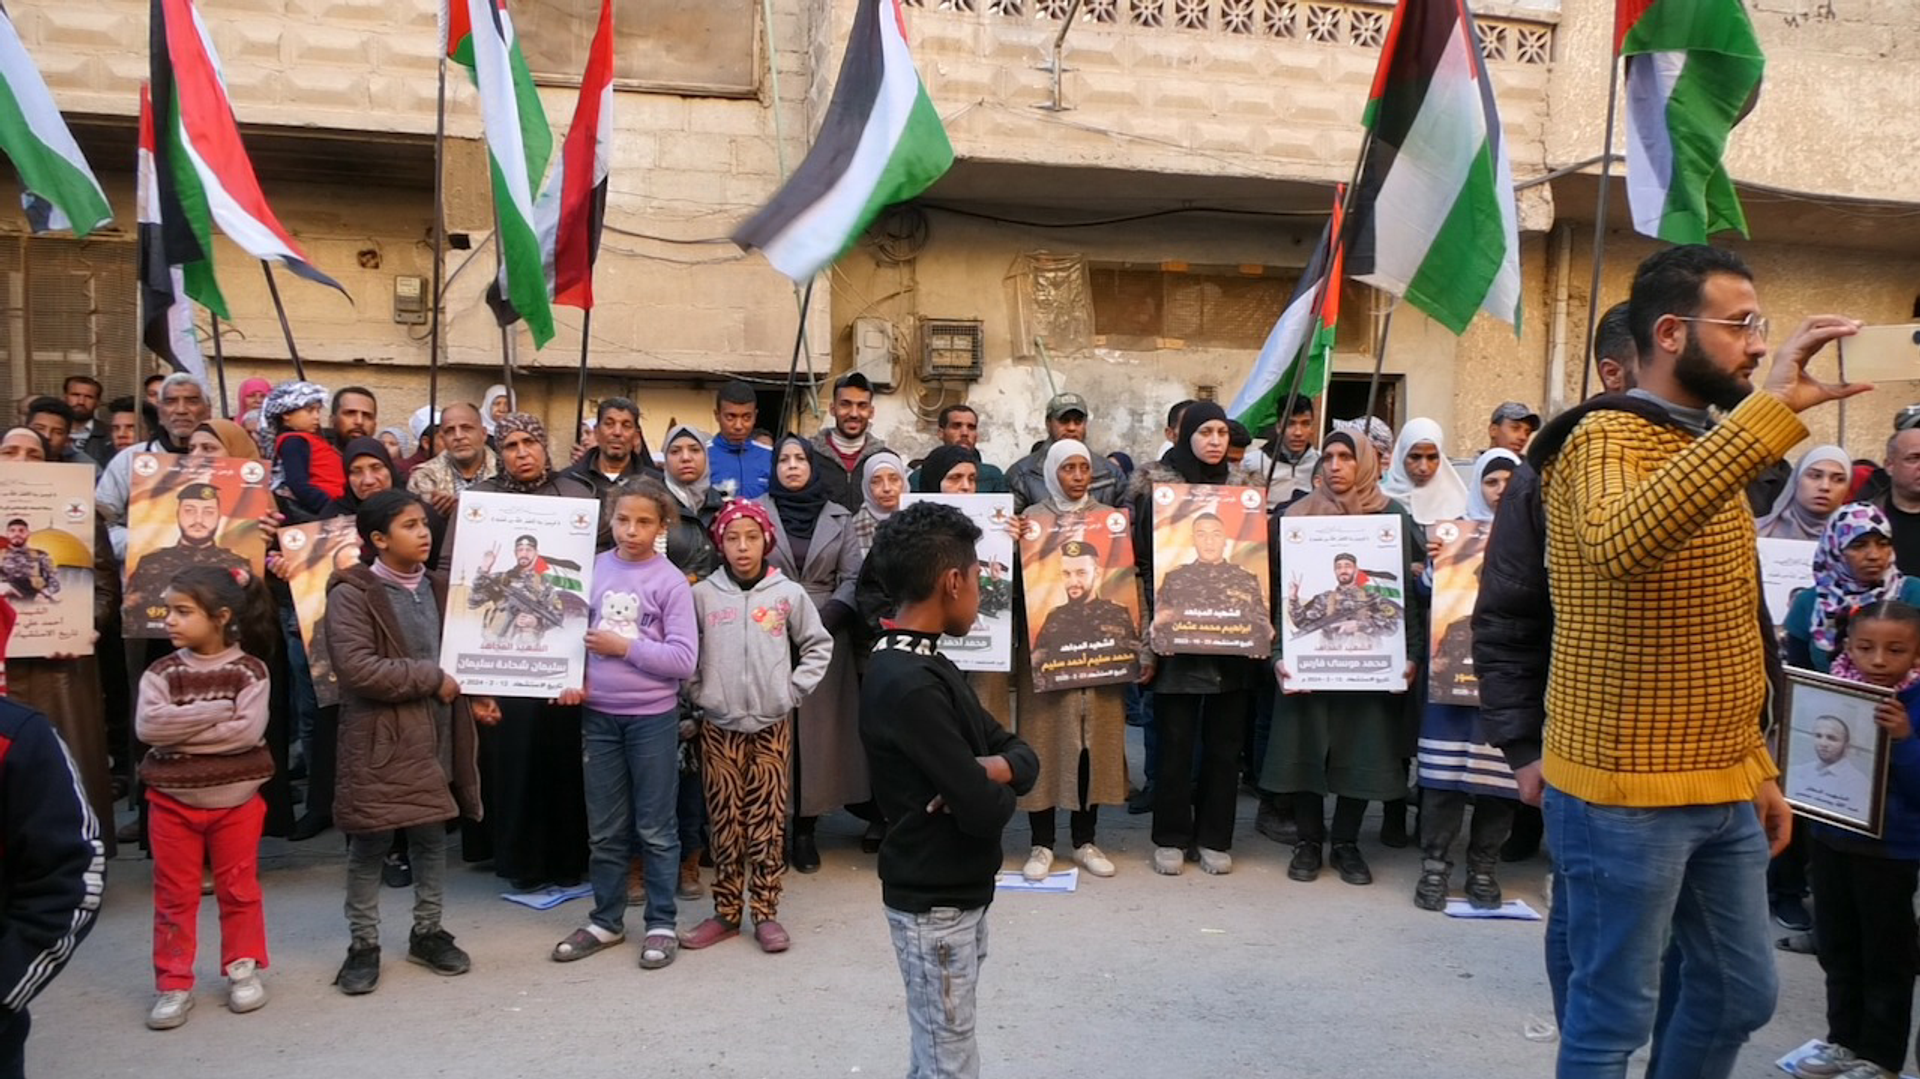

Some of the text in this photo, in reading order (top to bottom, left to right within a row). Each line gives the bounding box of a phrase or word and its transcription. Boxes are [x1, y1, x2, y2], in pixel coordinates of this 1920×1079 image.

[1183, 608, 1241, 618] الشهيد المجاهد
[1172, 621, 1198, 632] عثمان
[1199, 624, 1221, 632] محمد
[480, 642, 549, 653] الشهيد المجاهد
[1060, 638, 1115, 652] الشهيد المجاهد
[457, 657, 567, 672] سليمان شحادة سليمان
[1041, 652, 1135, 672] محمد سليم أحمد سليم
[1298, 658, 1325, 669] فارس
[1362, 660, 1388, 668] محمد
